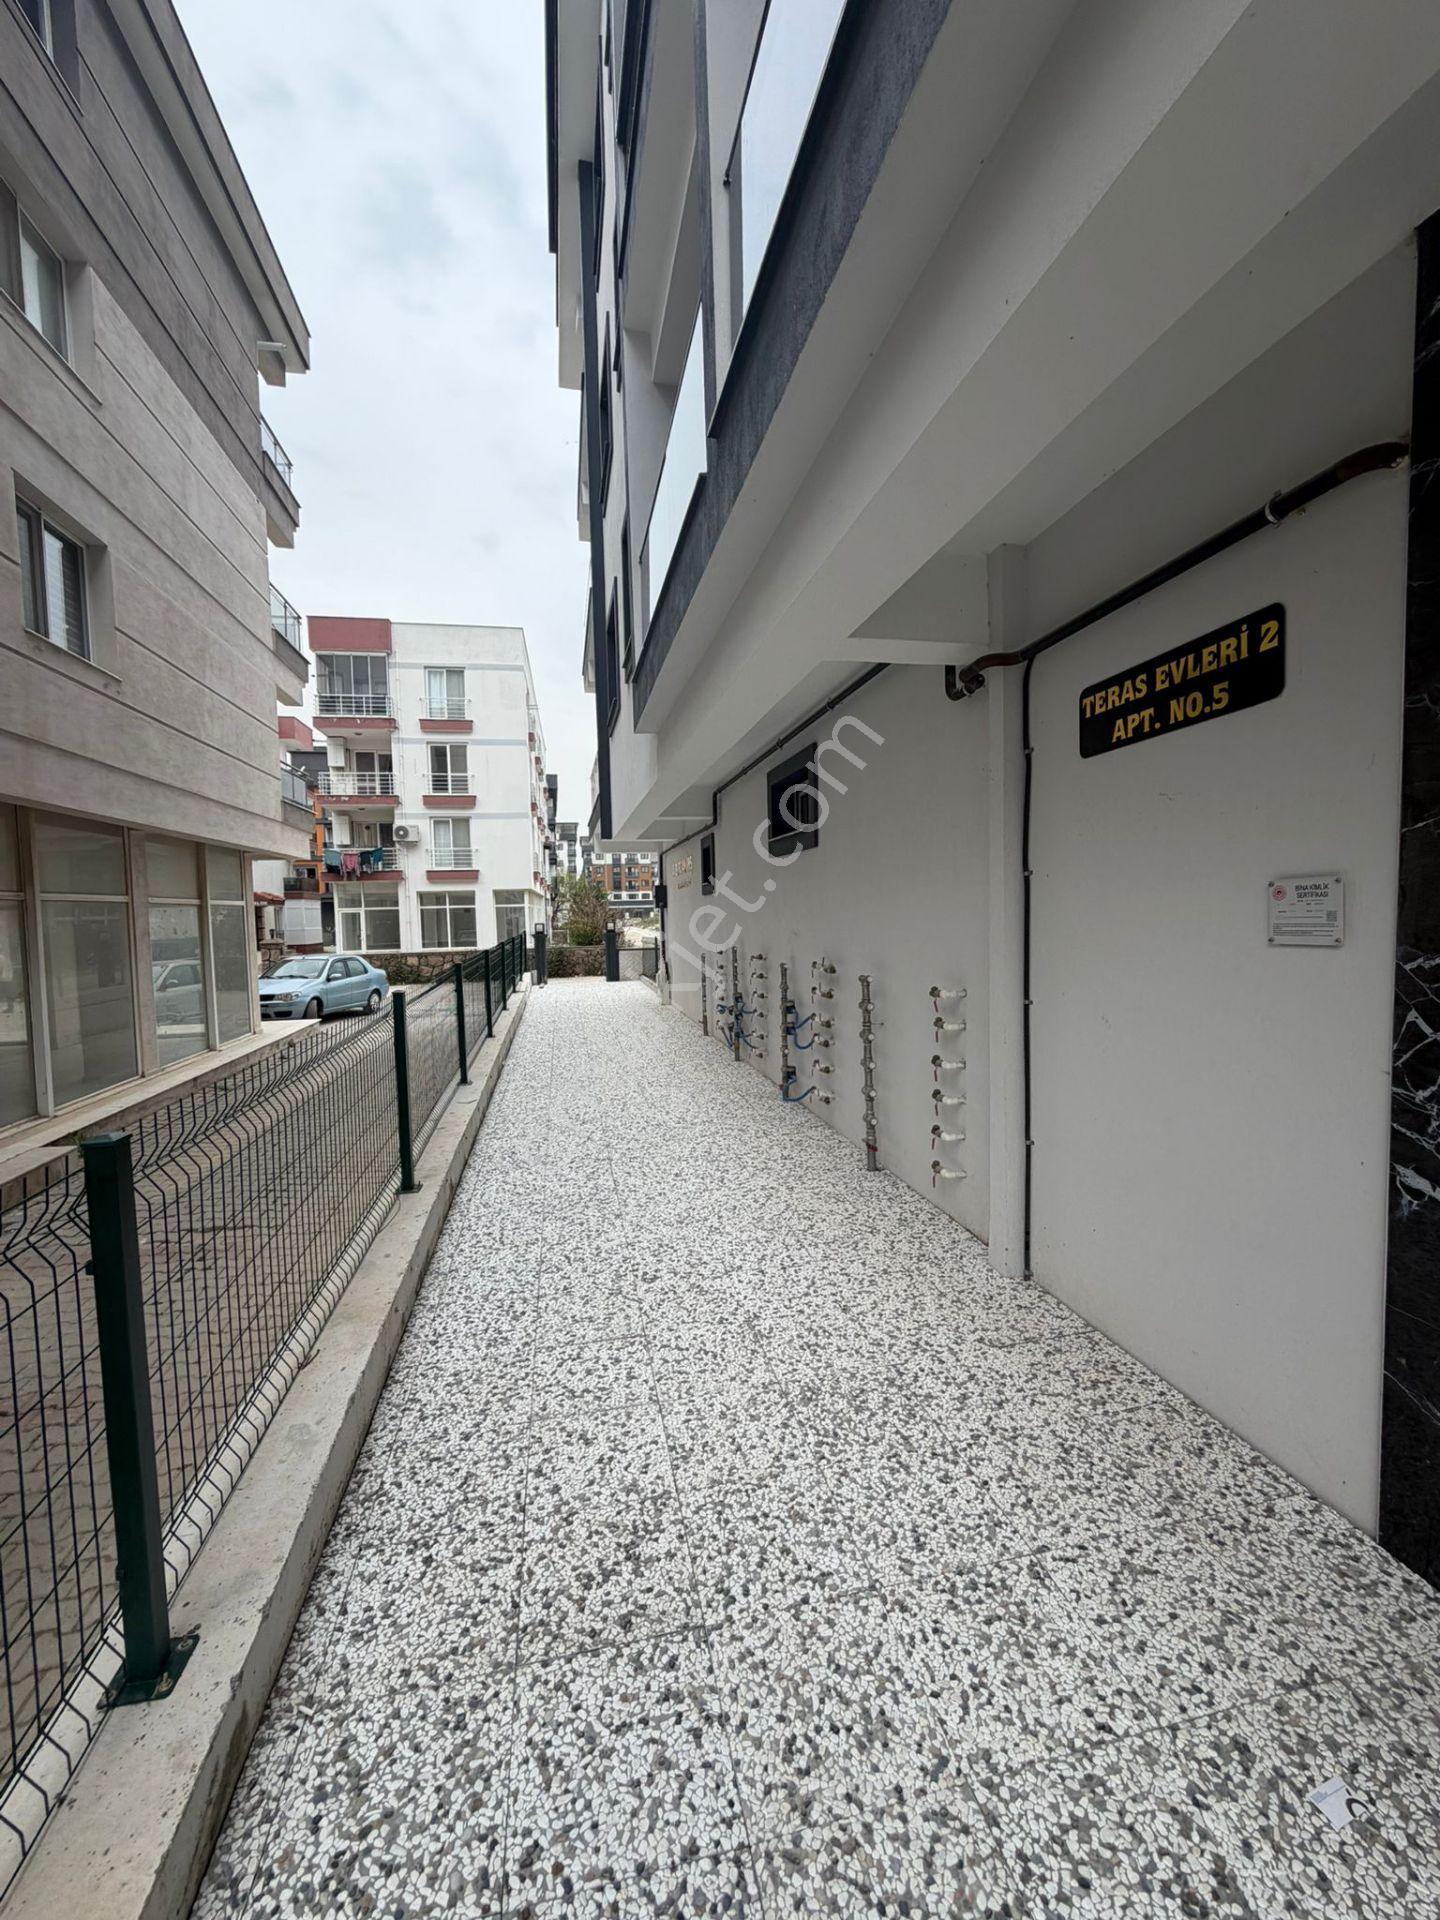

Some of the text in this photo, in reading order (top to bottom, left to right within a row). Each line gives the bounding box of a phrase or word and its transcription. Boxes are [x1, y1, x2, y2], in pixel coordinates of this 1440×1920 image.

[1082, 620, 1280, 719] TERAS EVLERİ 2
[1112, 681, 1230, 743] APT. NO.5
